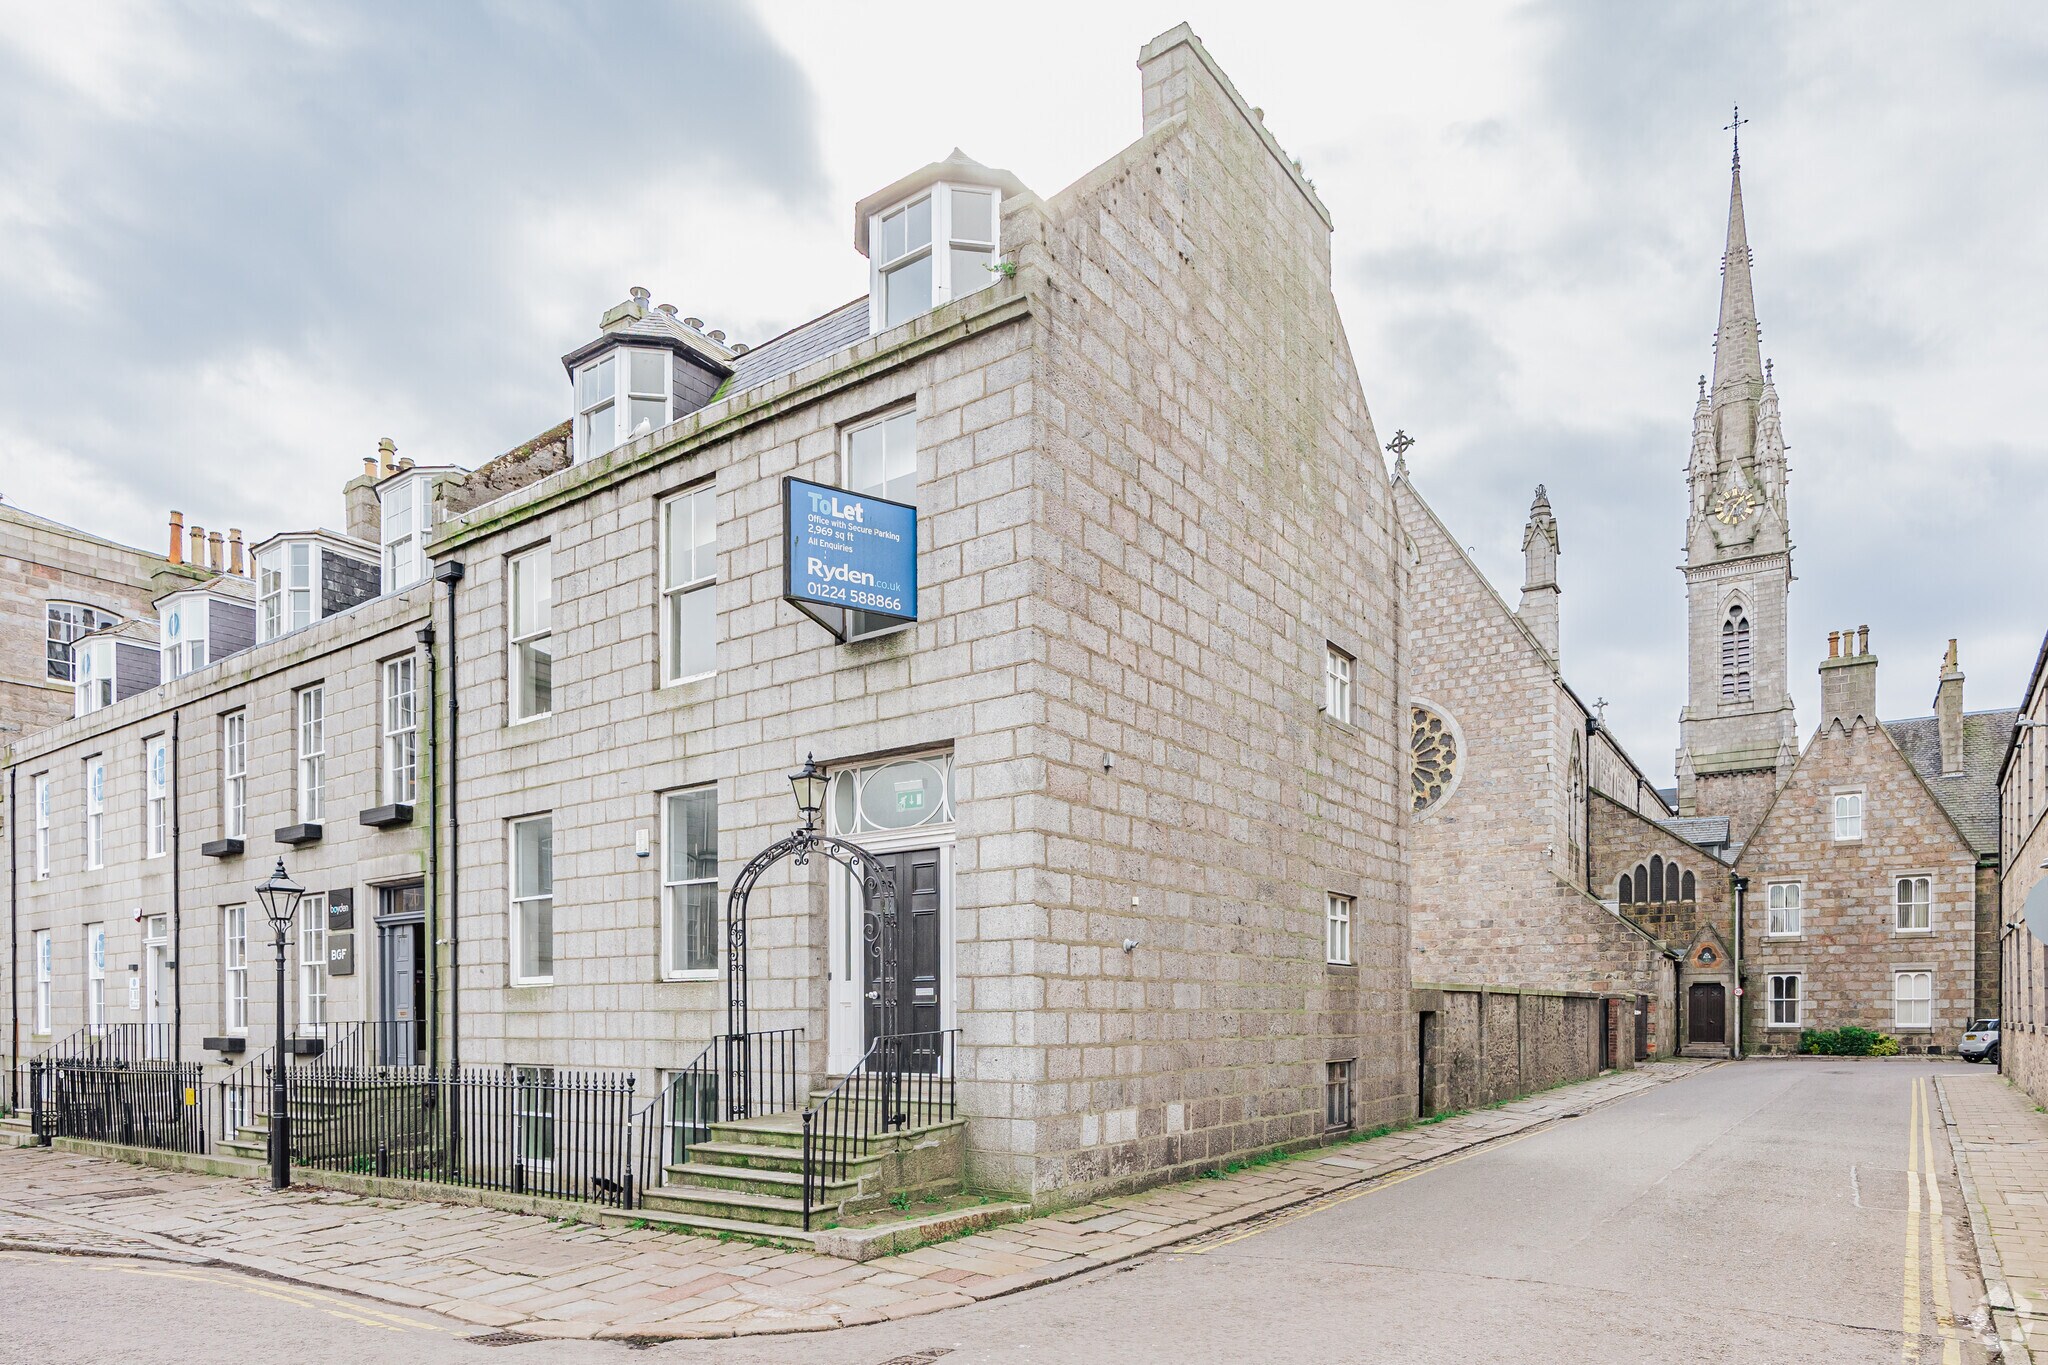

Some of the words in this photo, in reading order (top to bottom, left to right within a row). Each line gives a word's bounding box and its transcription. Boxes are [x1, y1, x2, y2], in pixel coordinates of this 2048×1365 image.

[808, 514, 830, 526] Office
[831, 520, 846, 529] with
[848, 522, 873, 535] Secure
[874, 529, 900, 542] Parking
[808, 523, 833, 537] 2,969
[835, 531, 845, 542] sq
[847, 532, 854, 542] ft
[808, 536, 818, 546] All
[820, 539, 853, 553] Enquiries
[807, 581, 847, 601] 01224
[850, 589, 901, 611] 588866
[330, 903, 348, 915] boyden
[331, 948, 347, 961] BGF
